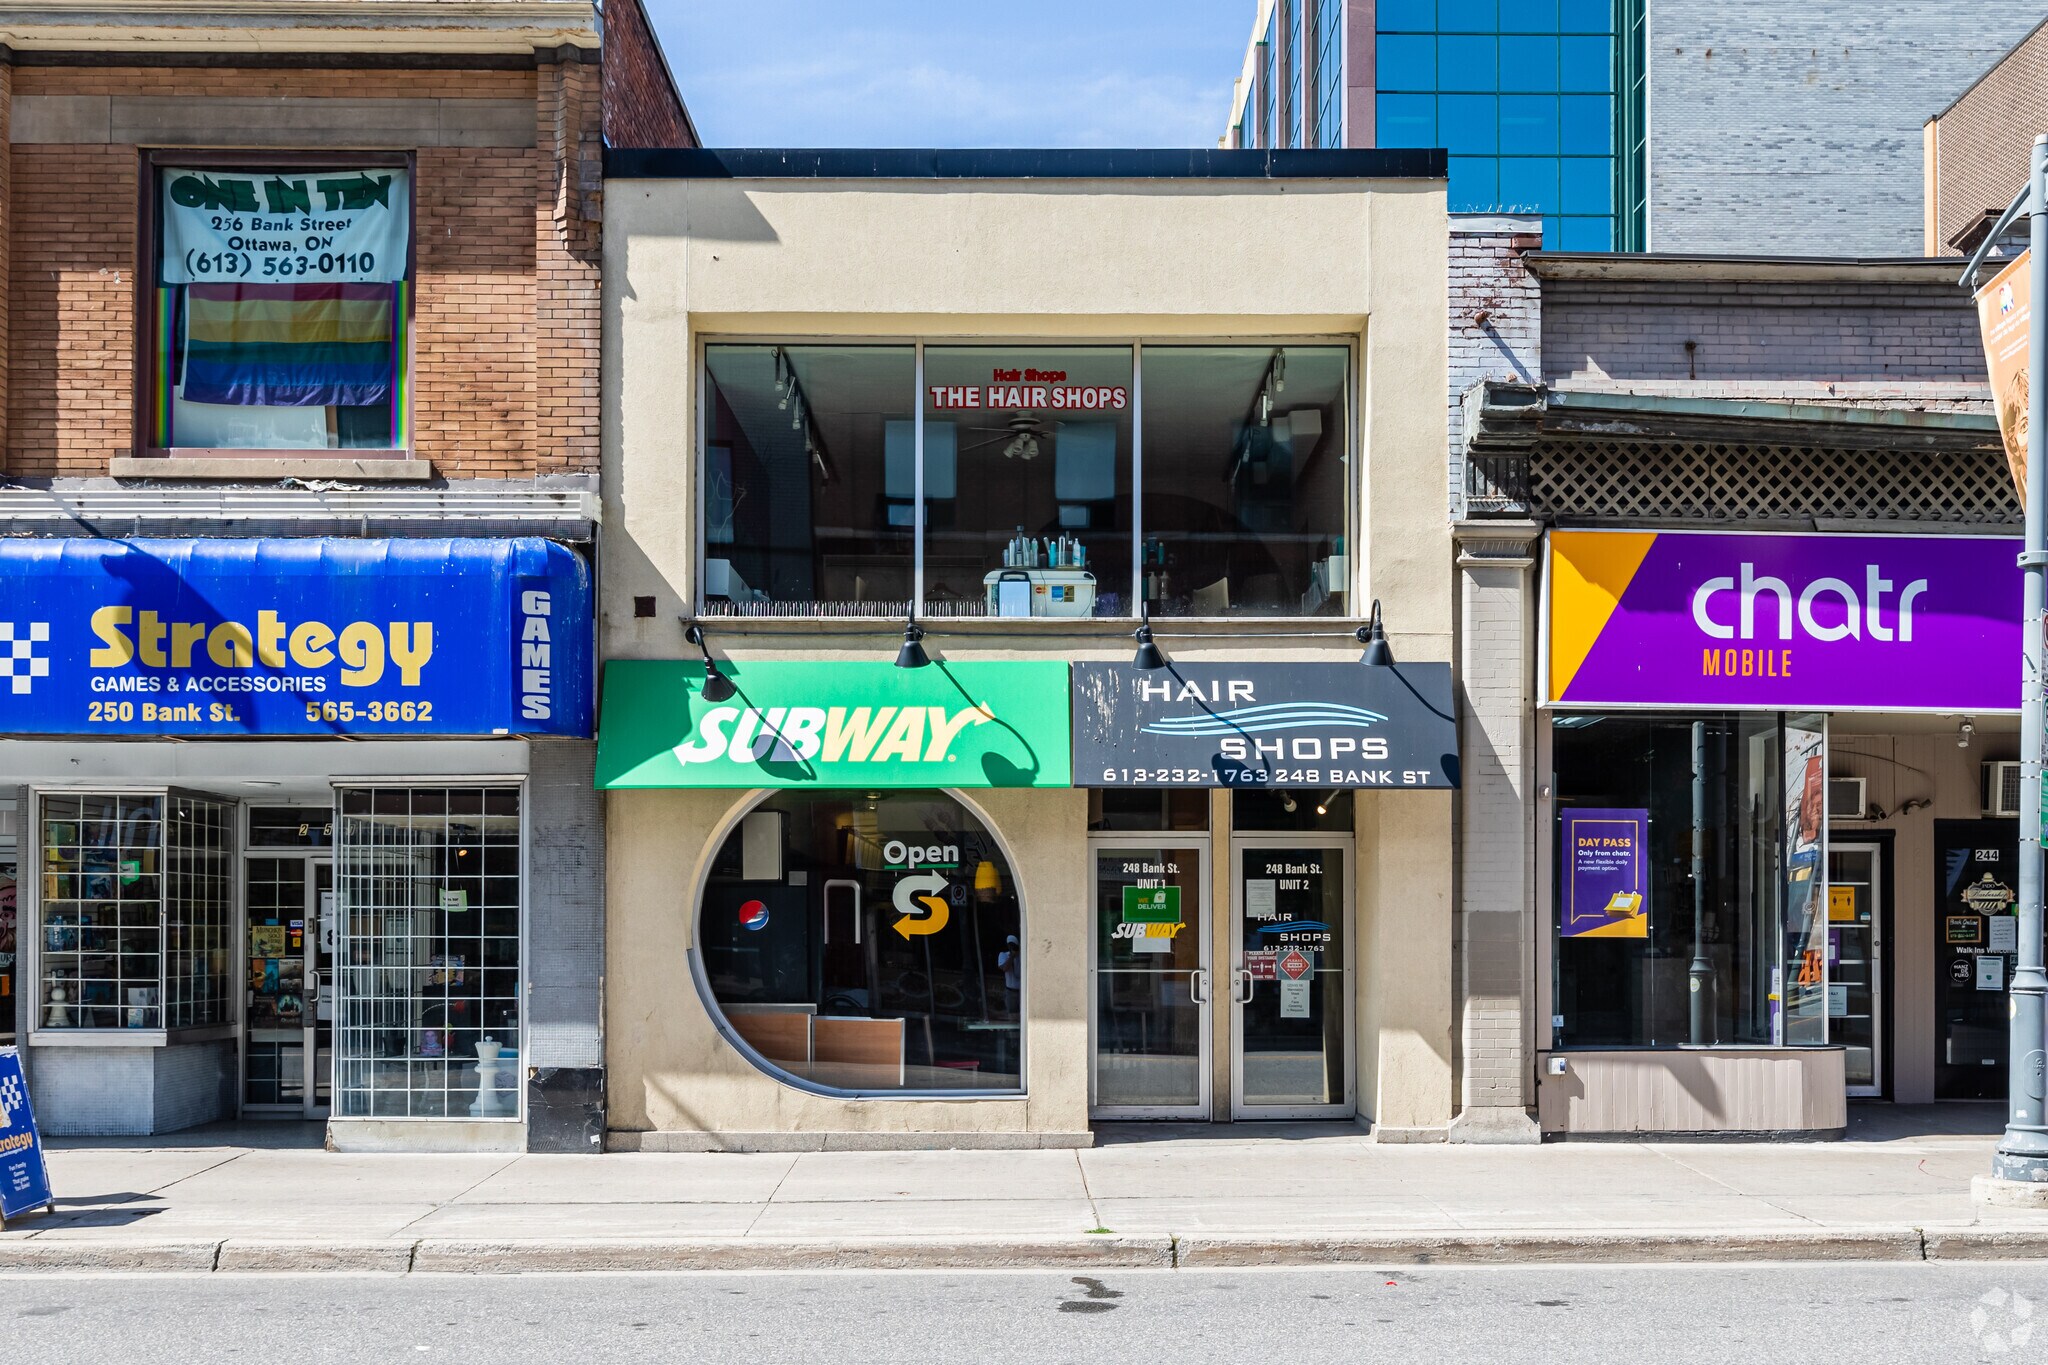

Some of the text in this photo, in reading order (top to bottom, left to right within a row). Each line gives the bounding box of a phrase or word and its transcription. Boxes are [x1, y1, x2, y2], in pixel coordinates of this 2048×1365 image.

[170, 172, 392, 216] ONE IN TEN
[211, 217, 352, 231] 256 Bank Street
[228, 236, 333, 254] Ottawa, ON
[185, 249, 375, 277] (613) 563-0110
[993, 369, 1067, 383] Hair Shops
[930, 386, 1128, 410] THE HAIR SHOPS
[1692, 562, 1928, 642] chatr
[90, 606, 433, 687] Strategy
[521, 590, 551, 720] GAMES
[1702, 648, 1792, 677] MOBILE
[91, 676, 326, 693] GAMES & ACCESSORIES
[1141, 680, 1257, 702] HAIR
[88, 701, 241, 722] 250 Bank St.
[306, 701, 433, 722] 565-3662
[672, 700, 996, 767] SUBWAY
[1220, 737, 1389, 760] SHOPS
[1103, 768, 1431, 784] 613-232-1763 248 BANK ST
[1578, 838, 1631, 847] DAY PASS
[883, 840, 959, 869] Open
[1578, 849, 1593, 857] Only
[1976, 850, 1999, 861] 244
[1123, 863, 1180, 873] 248 Bank St.
[1266, 864, 1323, 874] 248 Bank St.
[1137, 879, 1166, 889] UNIT 1
[1280, 880, 1309, 890] UNIT 2
[1257, 913, 1293, 921] HAIR
[1111, 922, 1186, 939] SUBWAY
[1280, 933, 1331, 941] SHOPS
[0, 1131, 33, 1152] rategy
